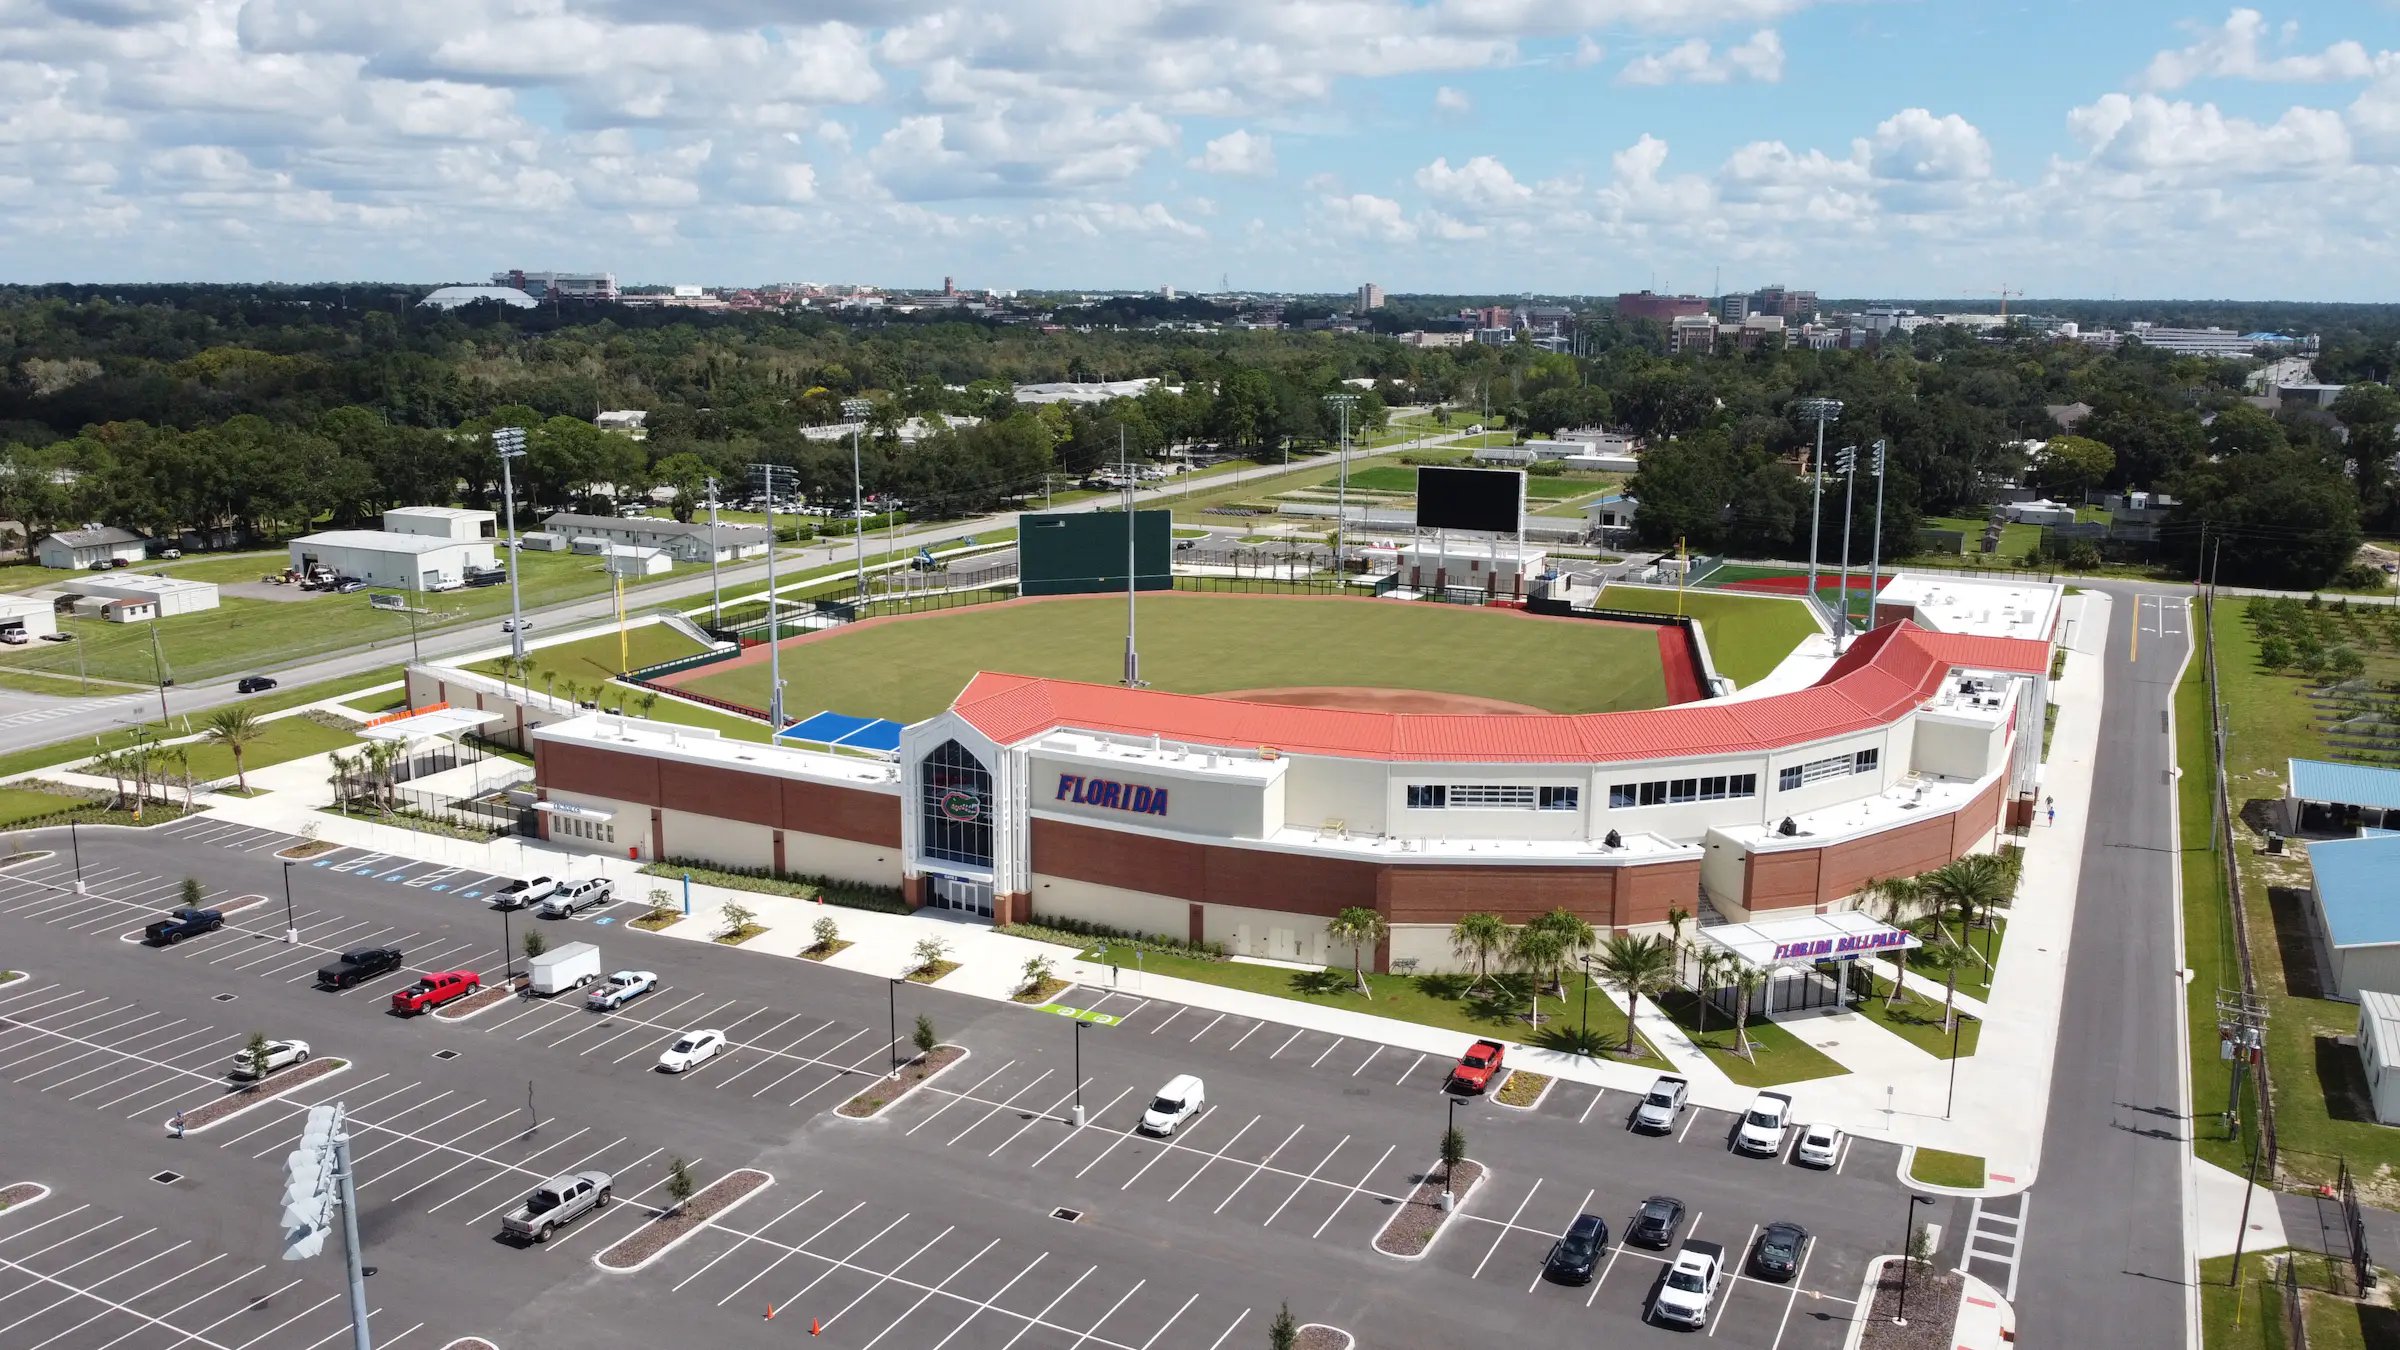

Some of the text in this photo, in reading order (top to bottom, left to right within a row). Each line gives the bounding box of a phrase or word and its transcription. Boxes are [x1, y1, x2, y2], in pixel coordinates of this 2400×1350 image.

[1055, 773, 1168, 816] FLORIDA
[1773, 940, 1833, 960] FLORIDA
[1835, 929, 1910, 953] BALLPARK
